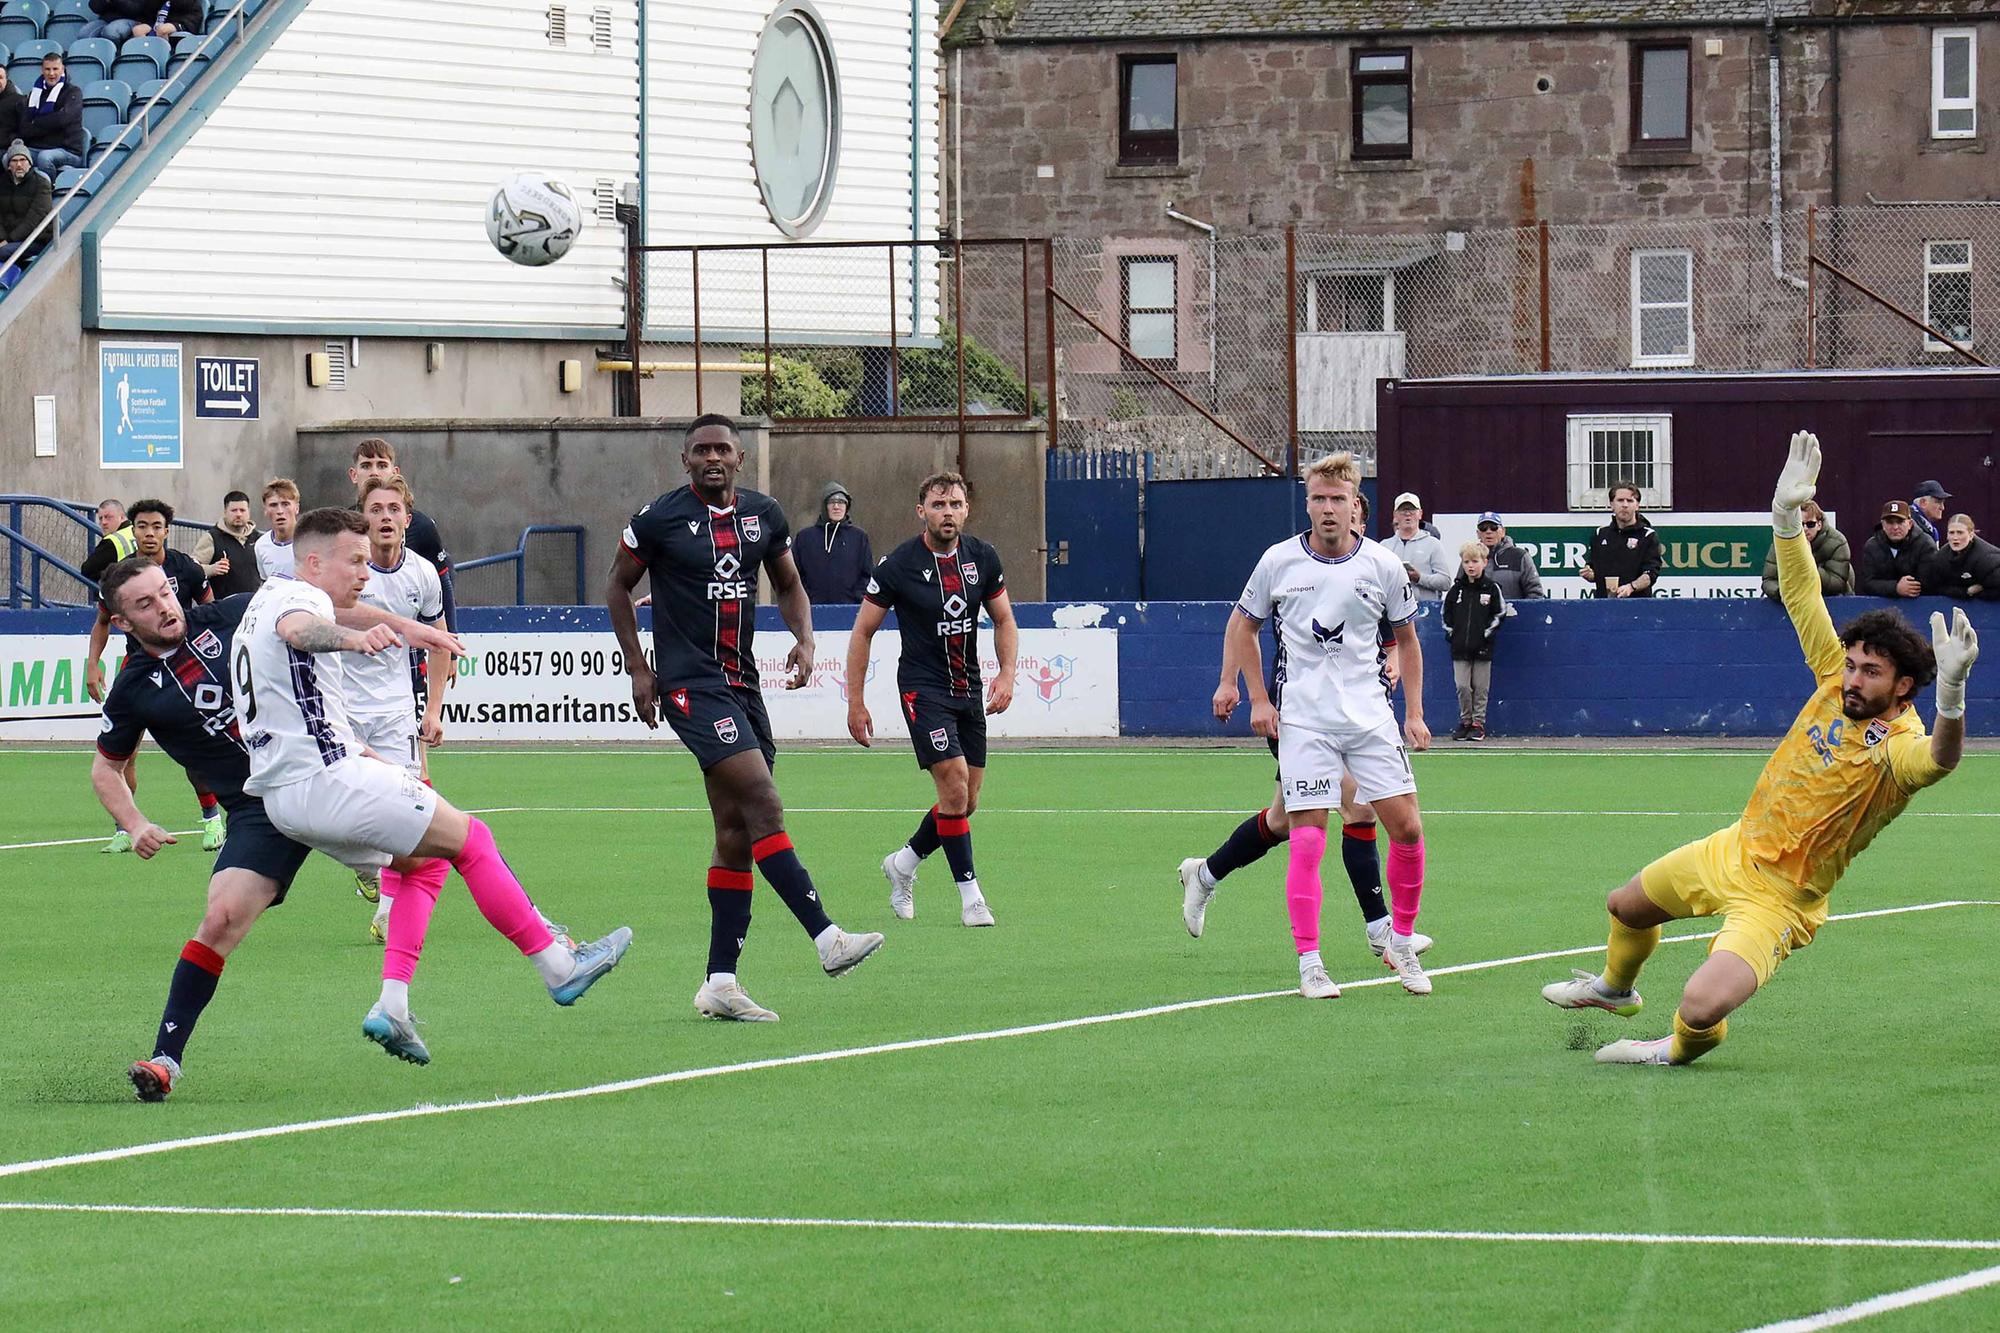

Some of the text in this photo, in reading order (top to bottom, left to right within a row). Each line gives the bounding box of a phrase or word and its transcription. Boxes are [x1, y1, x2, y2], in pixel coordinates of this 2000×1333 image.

[104, 352, 178, 368] FOOTBALL PLAYED HERE
[201, 362, 255, 392] TOILET
[1890, 503, 1899, 512] B
[1515, 541, 1753, 569] PER RUCE
[707, 580, 748, 600] RSE
[1286, 585, 1315, 593] uhlsport
[936, 617, 973, 637] RSE
[485, 651, 543, 676] 08457
[551, 651, 574, 676] 90
[581, 651, 604, 676] 90
[0, 656, 125, 707] MAR
[236, 644, 258, 724] 9
[1296, 779, 1331, 792] RJM
[1300, 789, 1329, 797] SPORTS
